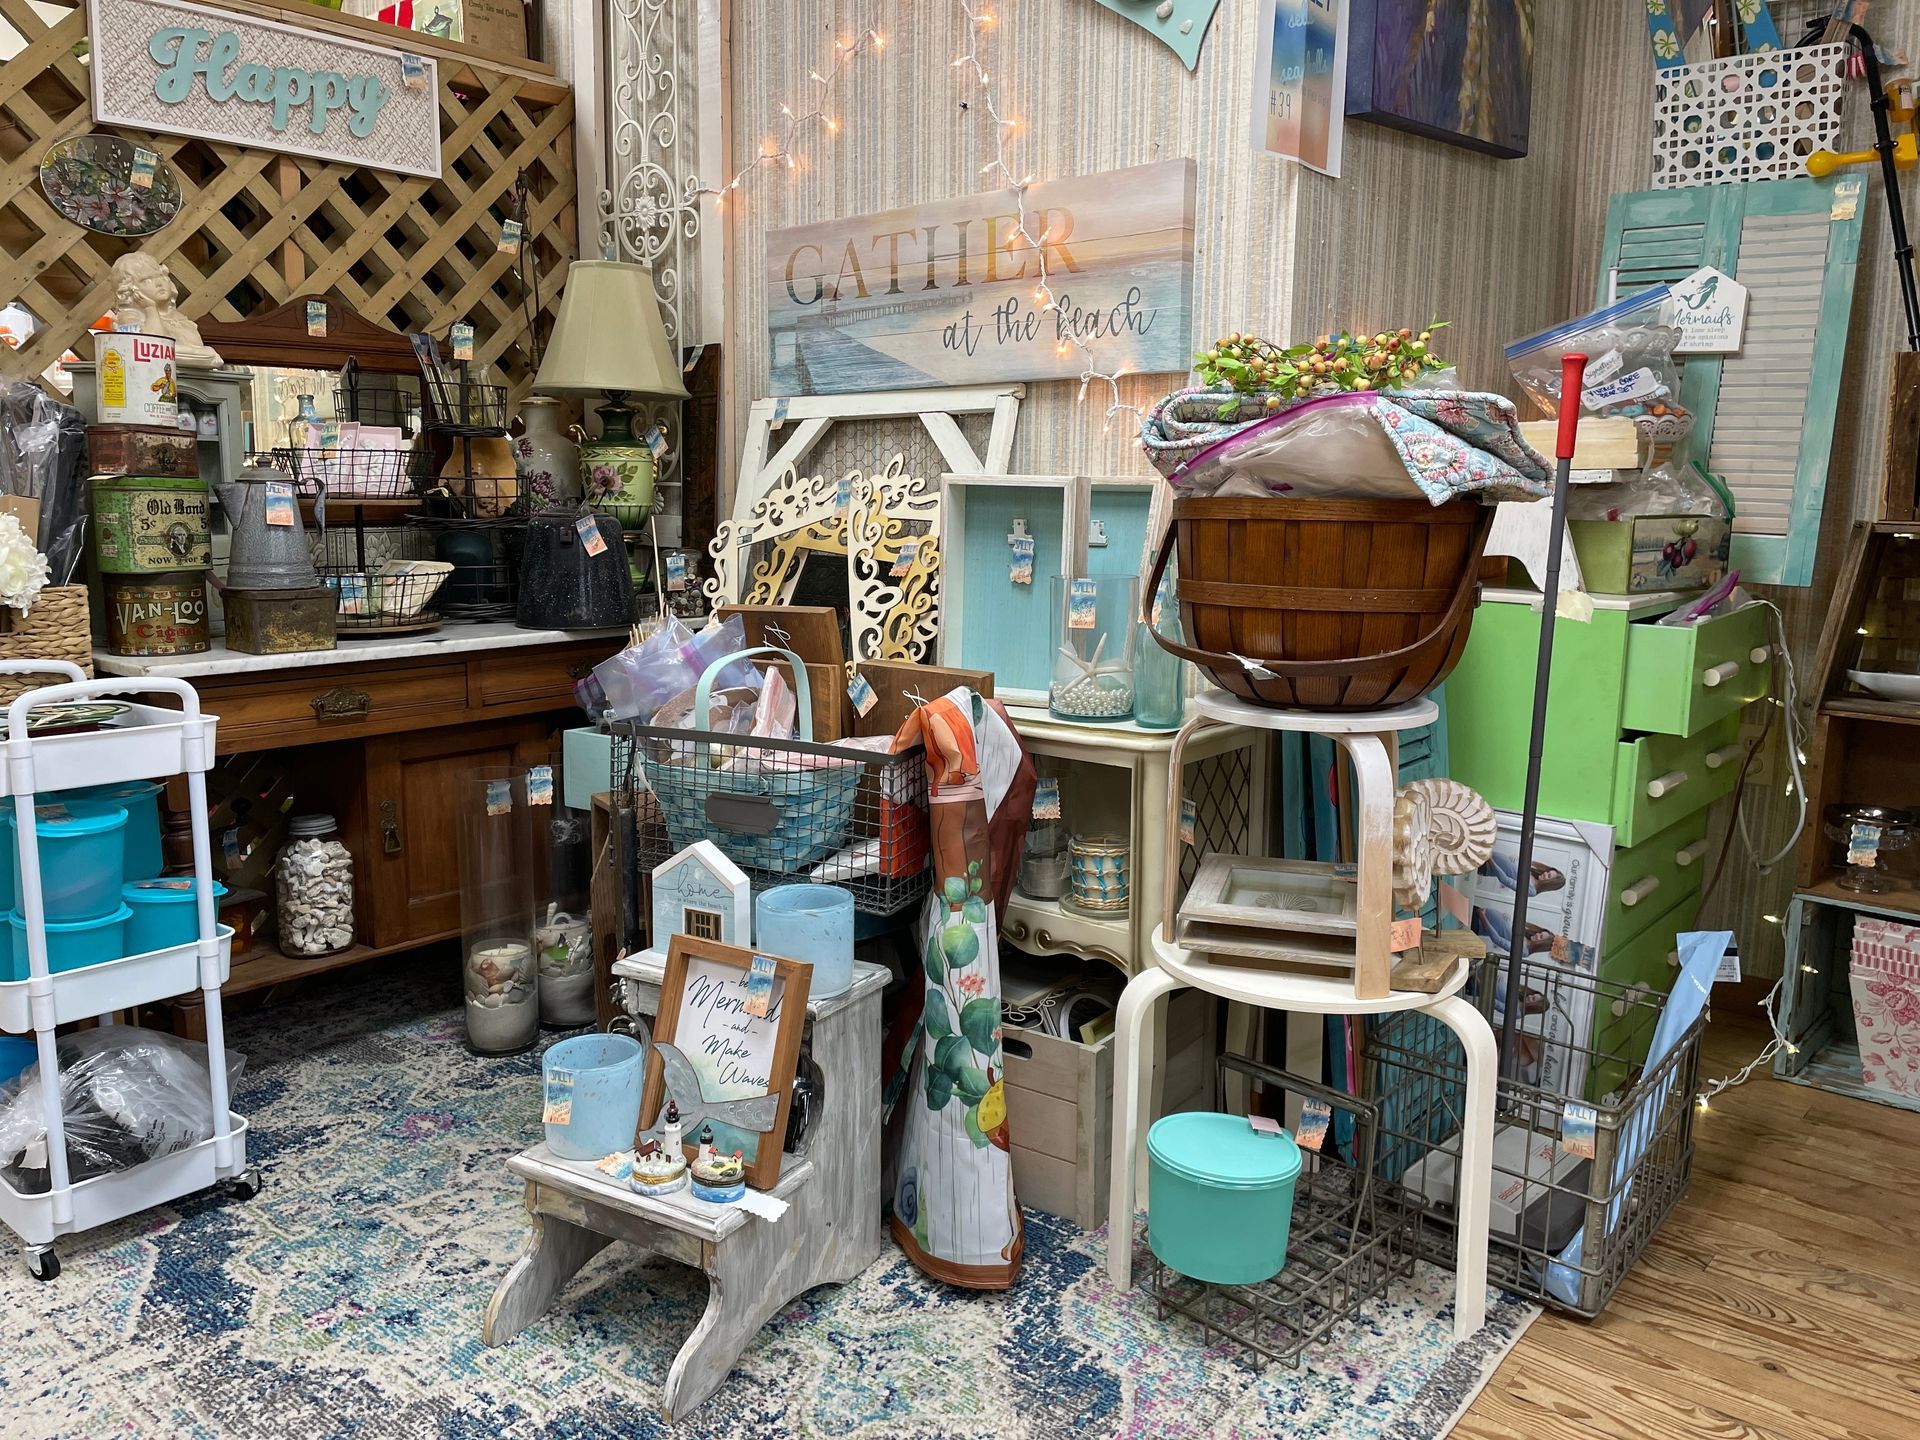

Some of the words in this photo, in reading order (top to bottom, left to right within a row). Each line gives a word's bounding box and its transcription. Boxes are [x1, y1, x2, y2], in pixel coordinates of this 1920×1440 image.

[150, 27, 391, 137] Happy
[1270, 89, 1291, 120] #39
[785, 207, 1086, 306] GATHER
[943, 310, 983, 357] at
[992, 296, 1042, 345] the
[1056, 286, 1158, 341] beach
[147, 499, 172, 515] Old
[175, 498, 205, 515] Bond
[148, 556, 172, 564] NOW
[1072, 582, 1095, 594] SALLY
[116, 600, 204, 635] VAN-LOO
[1570, 859, 1580, 873] Our
[752, 958, 775, 973] SALLY
[702, 1034, 751, 1068] Make
[551, 1071, 573, 1083] SALLY
[719, 1060, 770, 1088] Waves
[1567, 1103, 1594, 1119] SALLY
